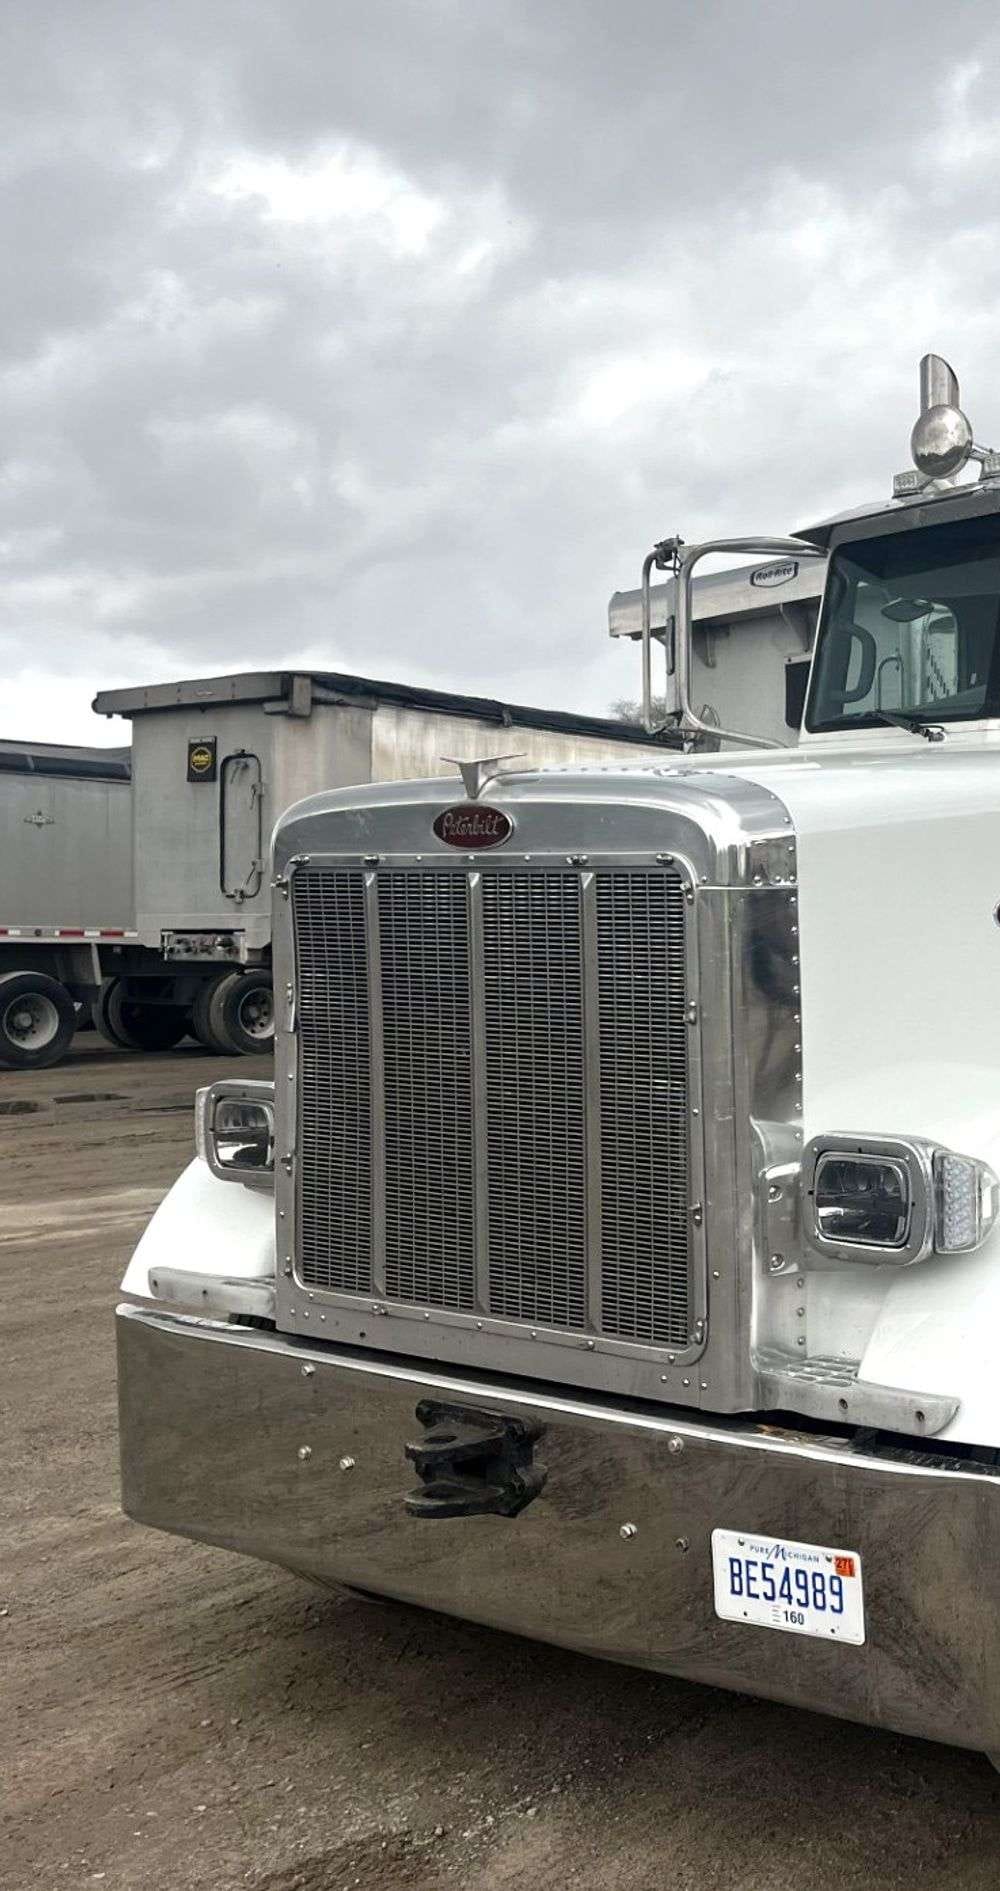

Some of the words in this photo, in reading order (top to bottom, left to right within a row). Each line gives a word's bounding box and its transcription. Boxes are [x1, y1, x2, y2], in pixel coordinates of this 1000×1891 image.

[442, 813, 504, 839] Peterbilt
[749, 1545, 769, 1555] PURE
[766, 1544, 820, 1563] MICHIGAN
[729, 1557, 844, 1614] BE54989
[783, 1610, 805, 1625] 160
